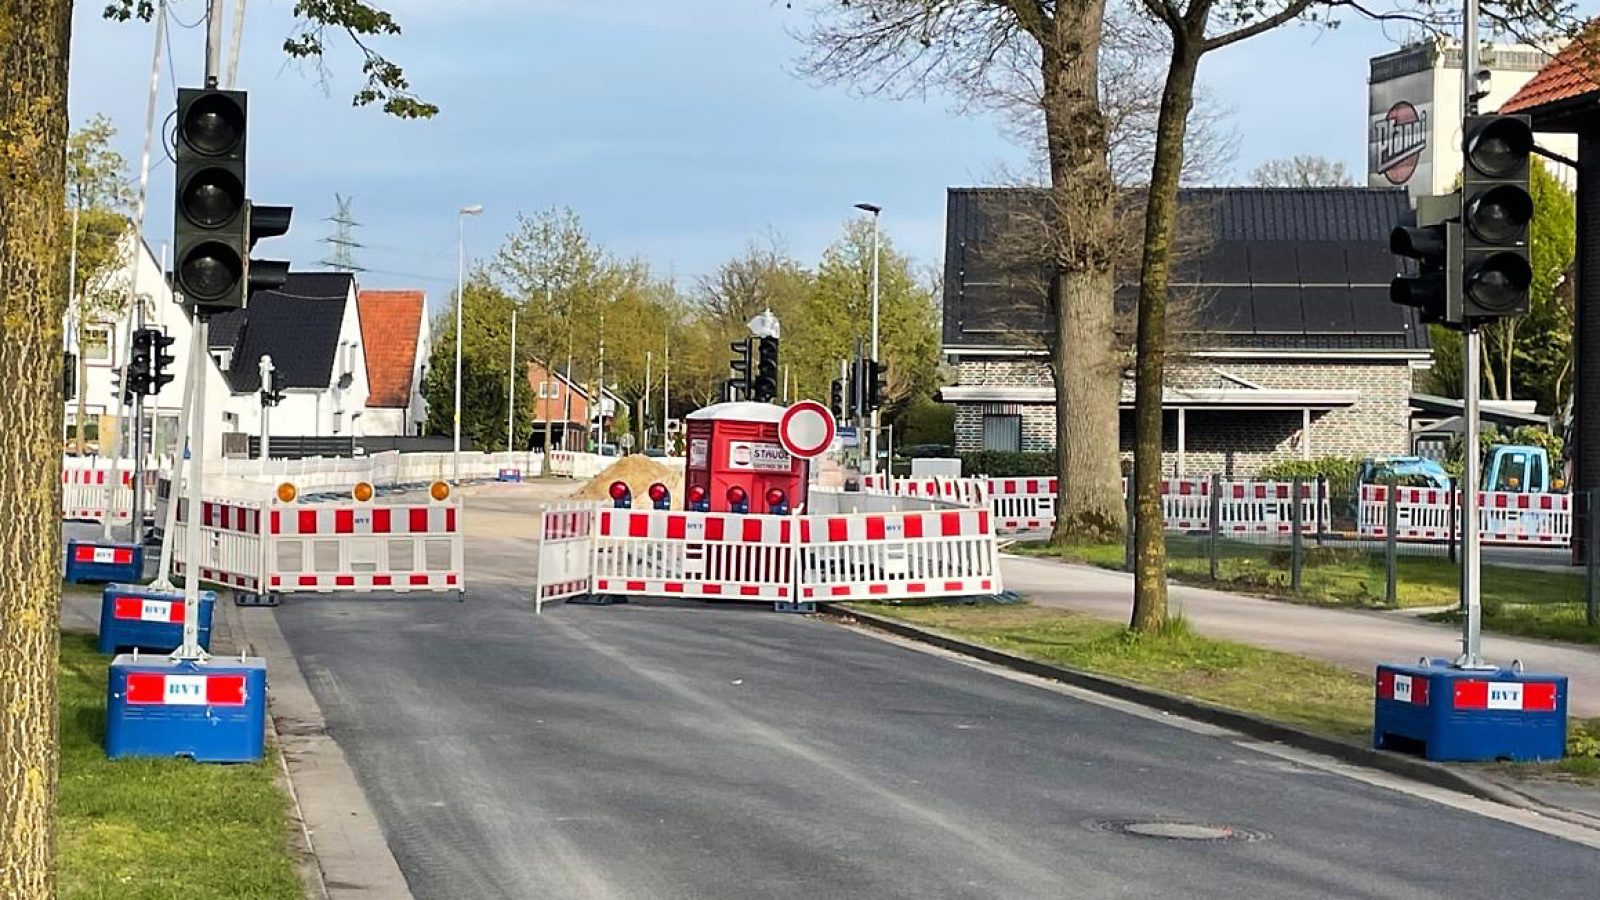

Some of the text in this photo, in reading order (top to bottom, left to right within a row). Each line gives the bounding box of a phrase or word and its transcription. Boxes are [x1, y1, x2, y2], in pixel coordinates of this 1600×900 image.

[1375, 109, 1427, 171] Pfanni
[169, 683, 202, 695] BVT
[1490, 689, 1519, 701] BVT
